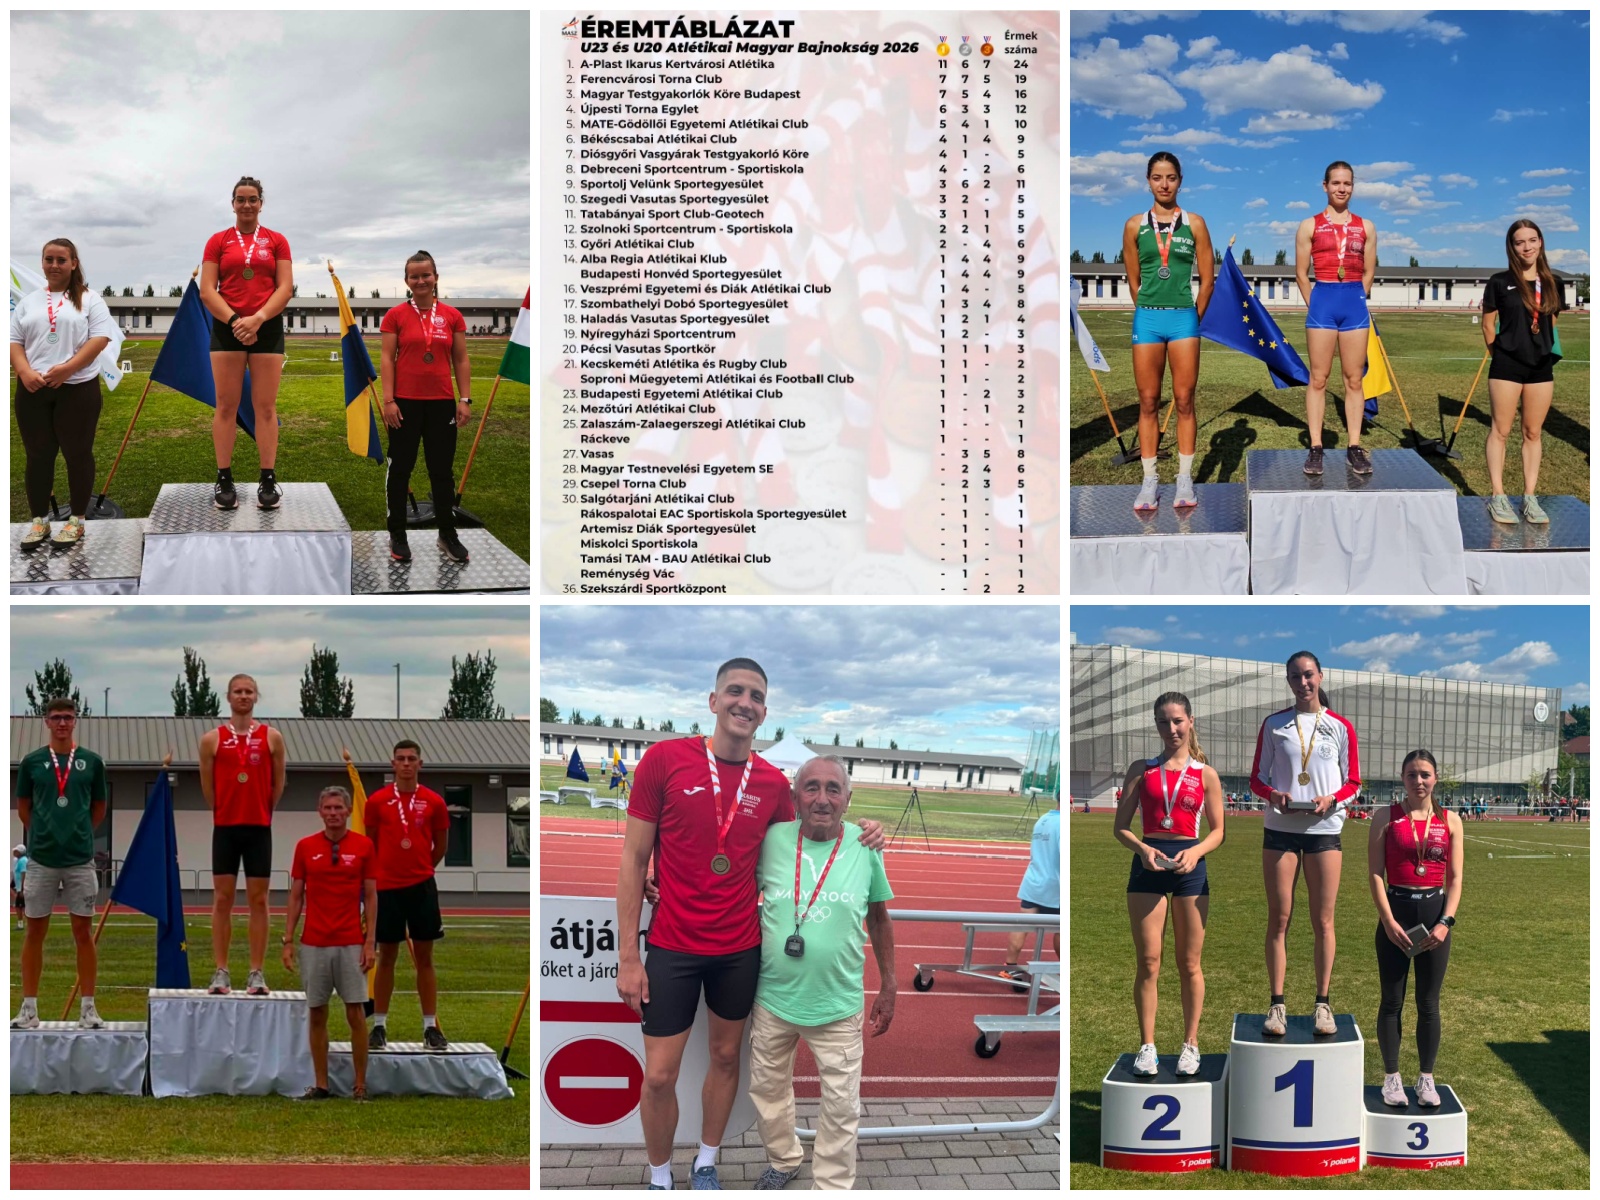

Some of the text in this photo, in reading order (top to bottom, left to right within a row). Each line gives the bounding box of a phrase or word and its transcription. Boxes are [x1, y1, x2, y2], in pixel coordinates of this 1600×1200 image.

[581, 14, 795, 39] ÉREMTÁBLÁZAT
[1004, 30, 1038, 40] Érmek
[580, 41, 920, 55] U23 és U20 Atlétikai Magyar Bajnokság 2026
[1004, 45, 1038, 54] száma
[567, 59, 1029, 68] 1. A-Plast Ikarus Kertvárosi Atlétika 11 6 7 24
[580, 74, 723, 83] Ferencvárosi Torna Club
[580, 89, 801, 100] Magyar Testgyakorlók Köre Budapest
[580, 103, 699, 115] Újpesti Torna Egylet
[580, 119, 809, 130] MATE-Gödöllői Egyetemi Atlétikai Club
[580, 134, 738, 143] Békéscsabai Atlétikai Club
[580, 149, 810, 160] Diósgyőri Vasgyárak Testgyakorló Köre
[580, 164, 804, 175] Debreceni Sportcentrum Sportiskola
[580, 179, 764, 190] Sportolj Velünk Sportegyesület
[580, 194, 769, 205] Szegedi Vasutas Sportegyesület
[579, 209, 764, 220] Tatabányai Sport Club-Geotech
[580, 224, 793, 235] Szolnoki Sportcentrum Sportiskola
[580, 239, 695, 250] Győri Atlétikai Club
[580, 254, 728, 265] Alba Regia Atlétikai Klub
[580, 269, 782, 280] Budapesti Honvéd Sportegyesület
[580, 284, 832, 295] Veszprémi Egyetemi és Diák Atlétikai Club
[580, 299, 789, 310] Szombathelyi Dobó Sportegyesület
[580, 314, 770, 325] Haladás Vasutas Sportegyesület
[580, 329, 736, 340] Nyíregyházi Sportcentrum
[580, 344, 716, 355] Pécsi Vasutas Sportkör
[580, 359, 788, 370] Kecskeméti Atlétika és Rugby Club
[580, 374, 855, 385] Soproni Műegyetemi Atlétikai és Football Club
[580, 389, 784, 400] Budapesti Egyetemi Atlétikai Club
[580, 404, 716, 413] Mezőtúri Atlétikai Club
[580, 419, 806, 430] Zalaszám-Zalaegerszegi Atlétikai Club
[580, 434, 631, 443] Ráckeve
[579, 450, 615, 458] Vasas
[580, 464, 774, 475] Magyar Testnevelési Egyetem SE
[580, 479, 687, 490] Csepel Torna Club
[580, 494, 735, 505] Salgótarjáni Atlétikai Club
[580, 509, 847, 520] Rákospalotai EAC Sportiskola Sportegyesület
[580, 524, 757, 535] Artemisz Diák Sportegyesület
[580, 539, 698, 550] Miskolci Sportiskola
[579, 554, 772, 563] Tamási TAM BAU Atlétikai Club
[580, 569, 675, 580] Reménység Vác
[580, 584, 727, 594] Szekszárdi Sportközpont
[743, 793, 761, 803] KARUS
[577, 966, 586, 978] a
[589, 962, 618, 982] járd
[1275, 1060, 1314, 1127] 1
[1142, 1095, 1180, 1140] 2
[1407, 1123, 1430, 1149] 3
[1188, 1158, 1216, 1167] polanik
[1330, 1156, 1356, 1167] polanik
[1436, 1158, 1461, 1168] polanik
